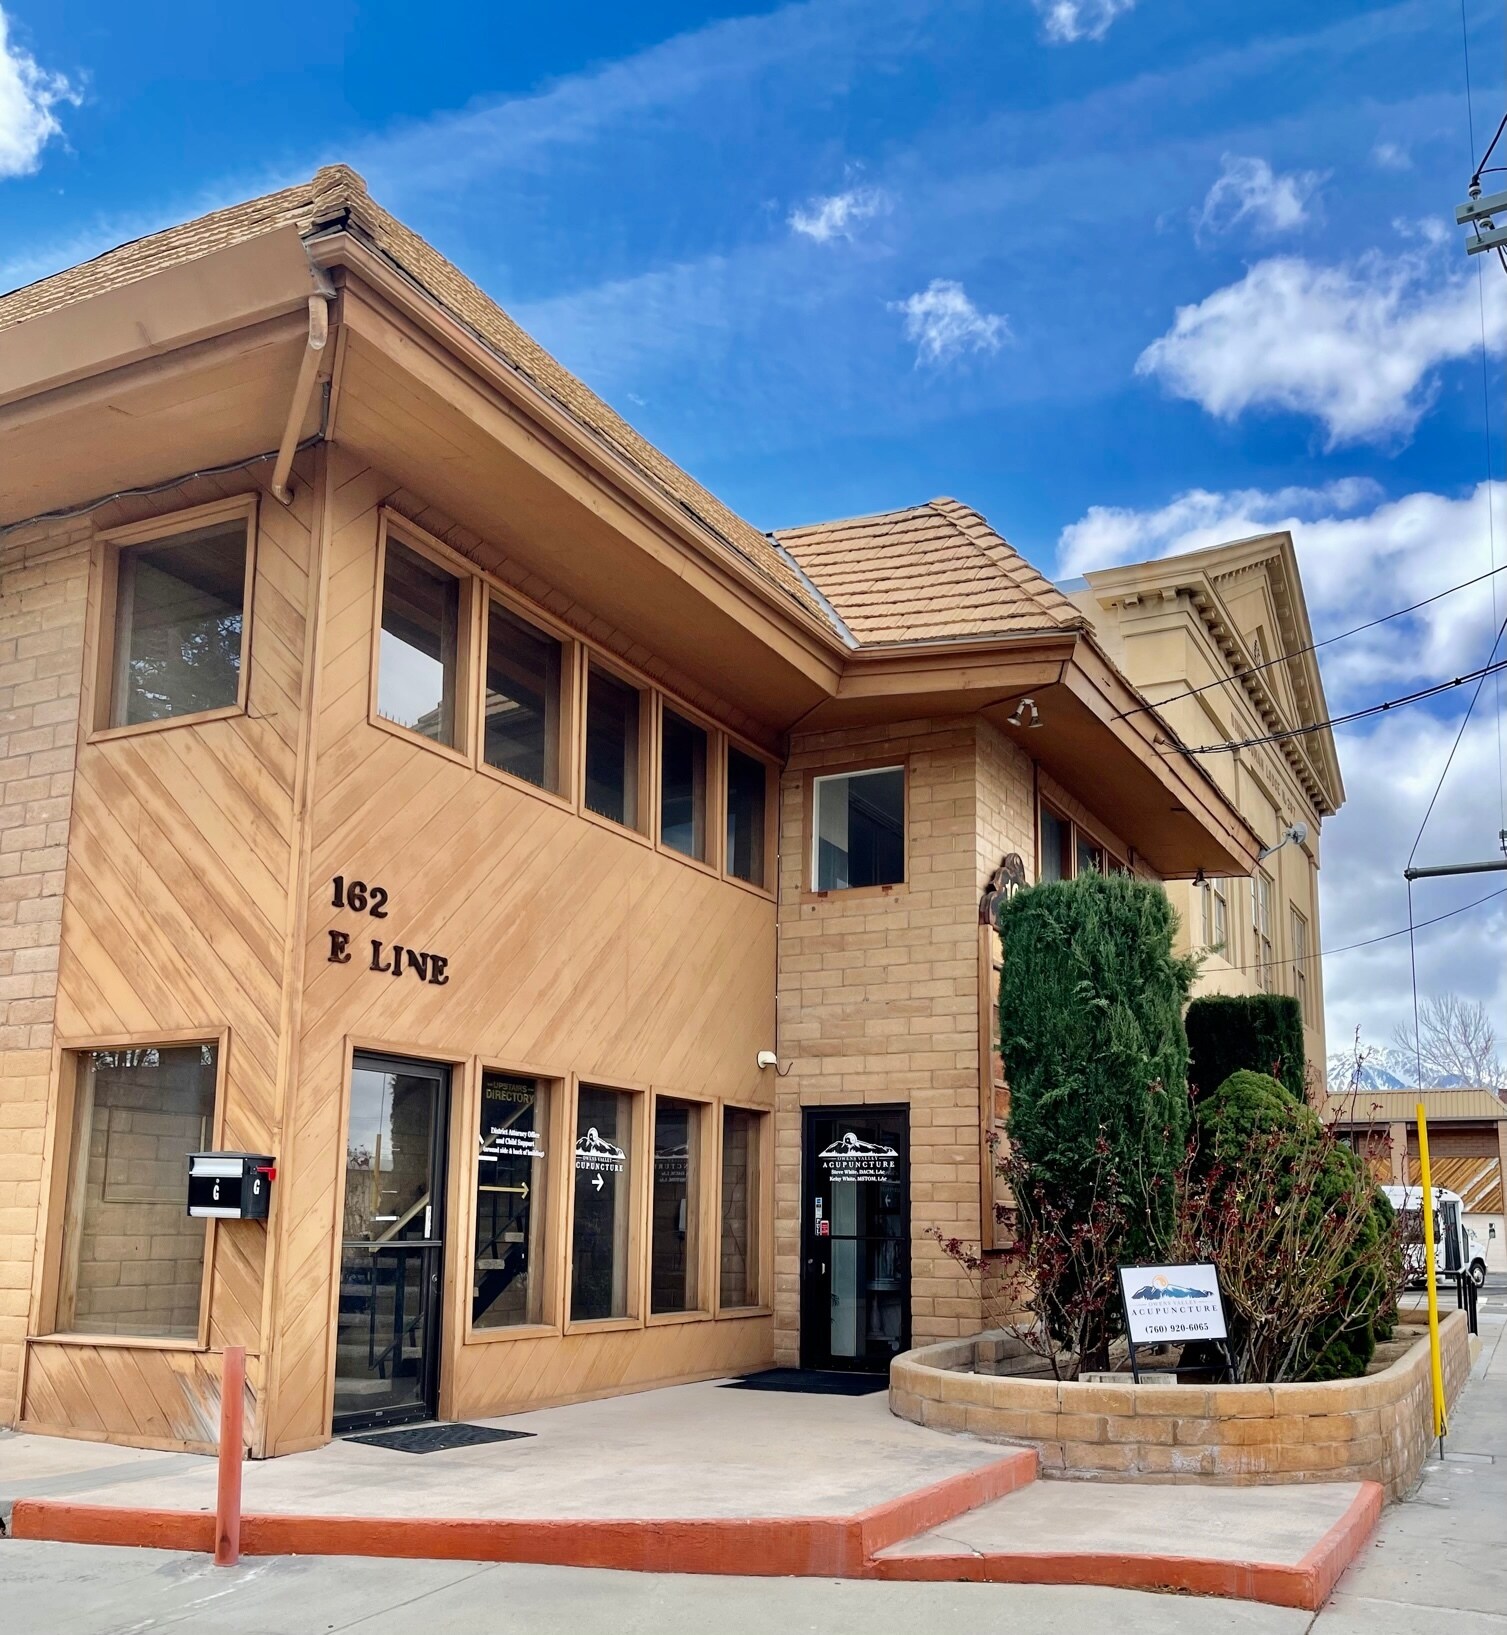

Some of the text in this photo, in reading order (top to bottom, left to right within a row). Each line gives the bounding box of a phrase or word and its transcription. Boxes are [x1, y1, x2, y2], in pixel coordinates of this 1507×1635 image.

[331, 875, 389, 919] 162
[328, 929, 449, 985] E LINE
[493, 1081, 528, 1093] UPSTAIRS
[486, 1089, 534, 1104] DIRECTORY
[490, 1126, 541, 1139] District Attorney Office
[504, 1137, 517, 1146] Child
[517, 1138, 535, 1148] Support
[499, 1146, 509, 1154] side
[575, 1161, 624, 1172] CUPUNCTURE
[213, 1184, 220, 1200] G
[253, 1179, 261, 1195] G
[1131, 1305, 1218, 1316] ACUPUNCTURE
[1145, 1322, 1209, 1334] (760) 920-6065
